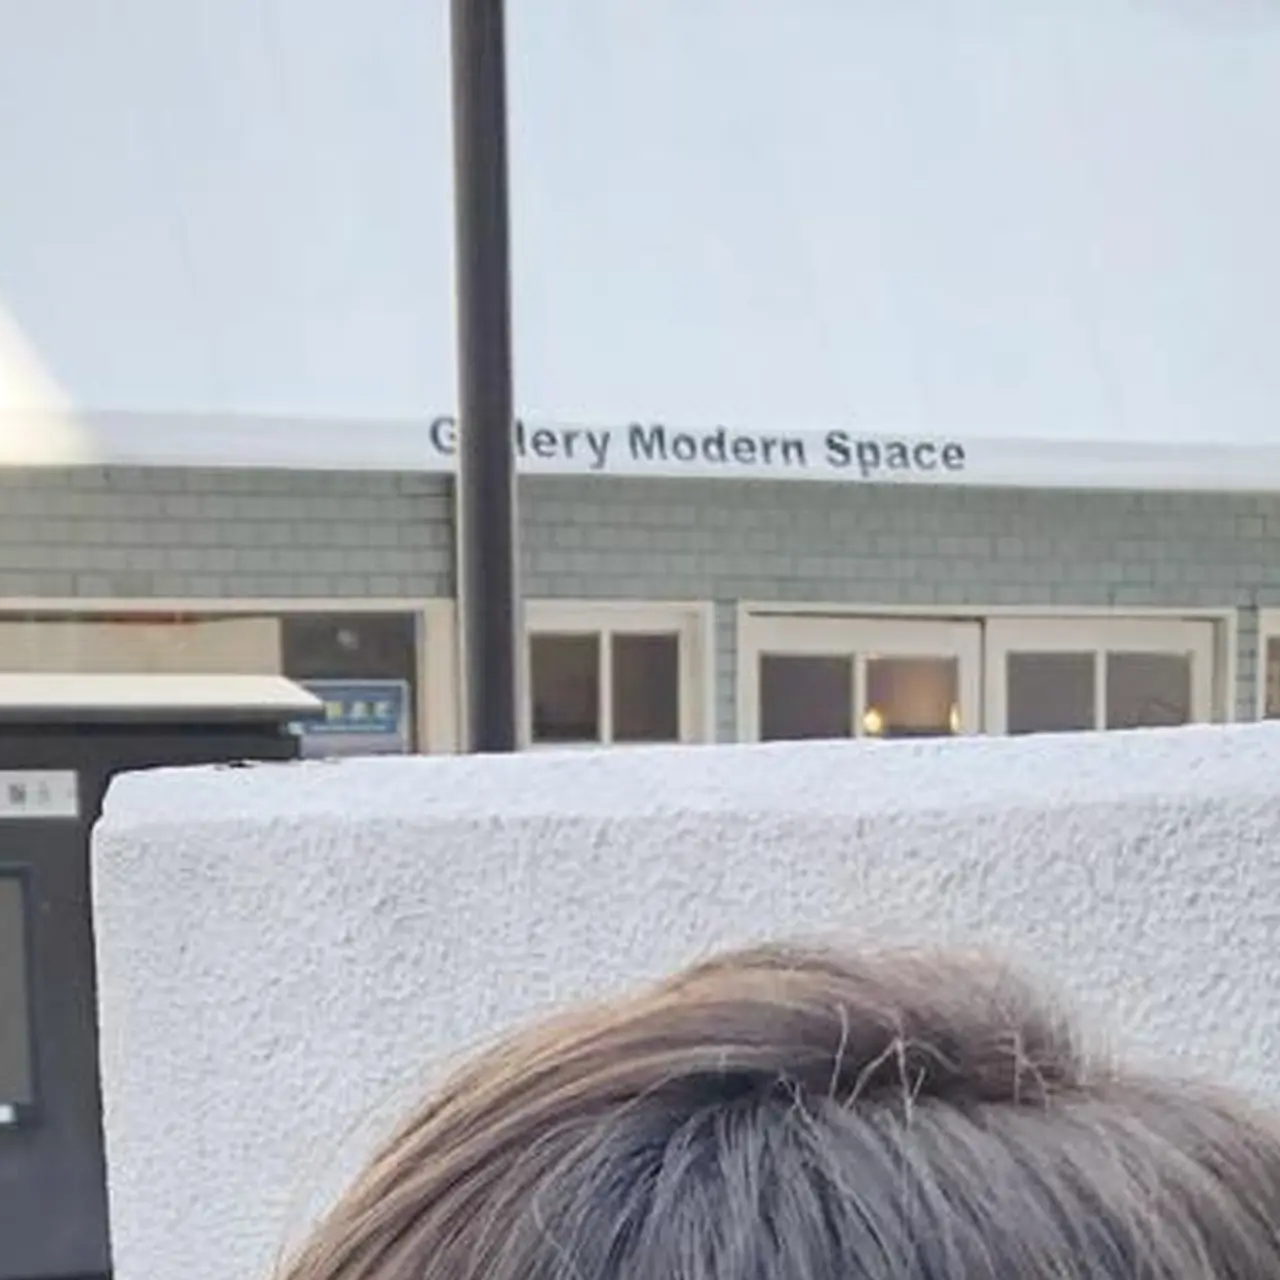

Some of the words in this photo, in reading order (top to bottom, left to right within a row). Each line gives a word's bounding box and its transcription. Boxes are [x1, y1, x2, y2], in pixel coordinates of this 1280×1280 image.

[429, 416, 610, 469] Glery
[628, 422, 806, 466] Modern
[824, 430, 966, 477] Space
